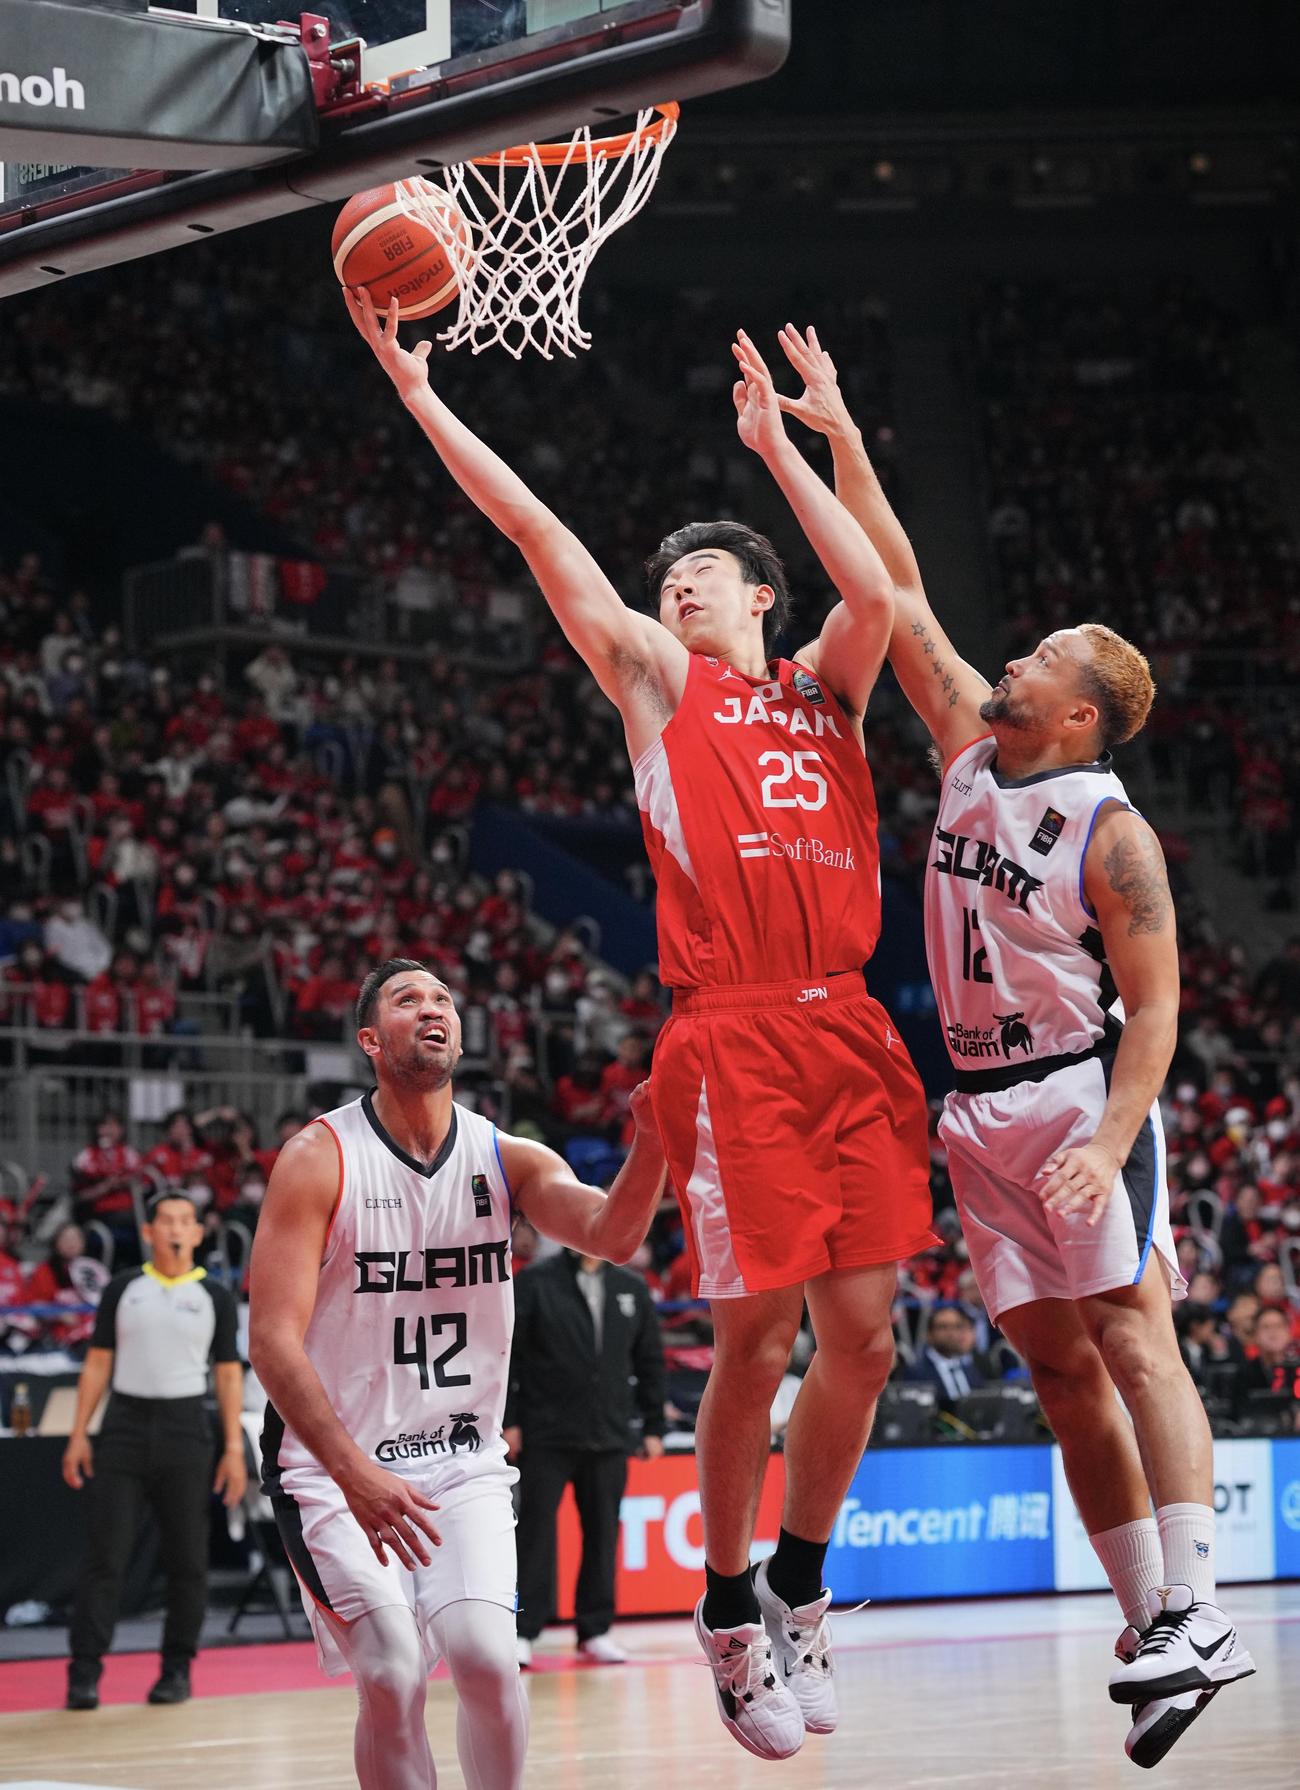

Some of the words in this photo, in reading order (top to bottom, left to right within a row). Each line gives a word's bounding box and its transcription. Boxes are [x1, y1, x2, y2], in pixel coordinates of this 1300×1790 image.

[383, 236, 414, 261] FIBA
[387, 259, 445, 297] molten
[801, 687, 818, 698] FIBA
[713, 696, 842, 739] JAPAN
[758, 751, 827, 811] 25
[770, 833, 856, 870] SoftBank
[1036, 832, 1053, 845] FIBA
[963, 907, 993, 984] 12
[797, 987, 828, 1003] JPN
[956, 1023, 980, 1040] Bank
[983, 1027, 995, 1040] of
[353, 1240, 510, 1293] GUAM
[394, 1313, 471, 1390] 42
[375, 1438, 446, 1462] Guam
[397, 1431, 426, 1444] Bank
[430, 1426, 445, 1439] of
[834, 1498, 984, 1549] Tencent
